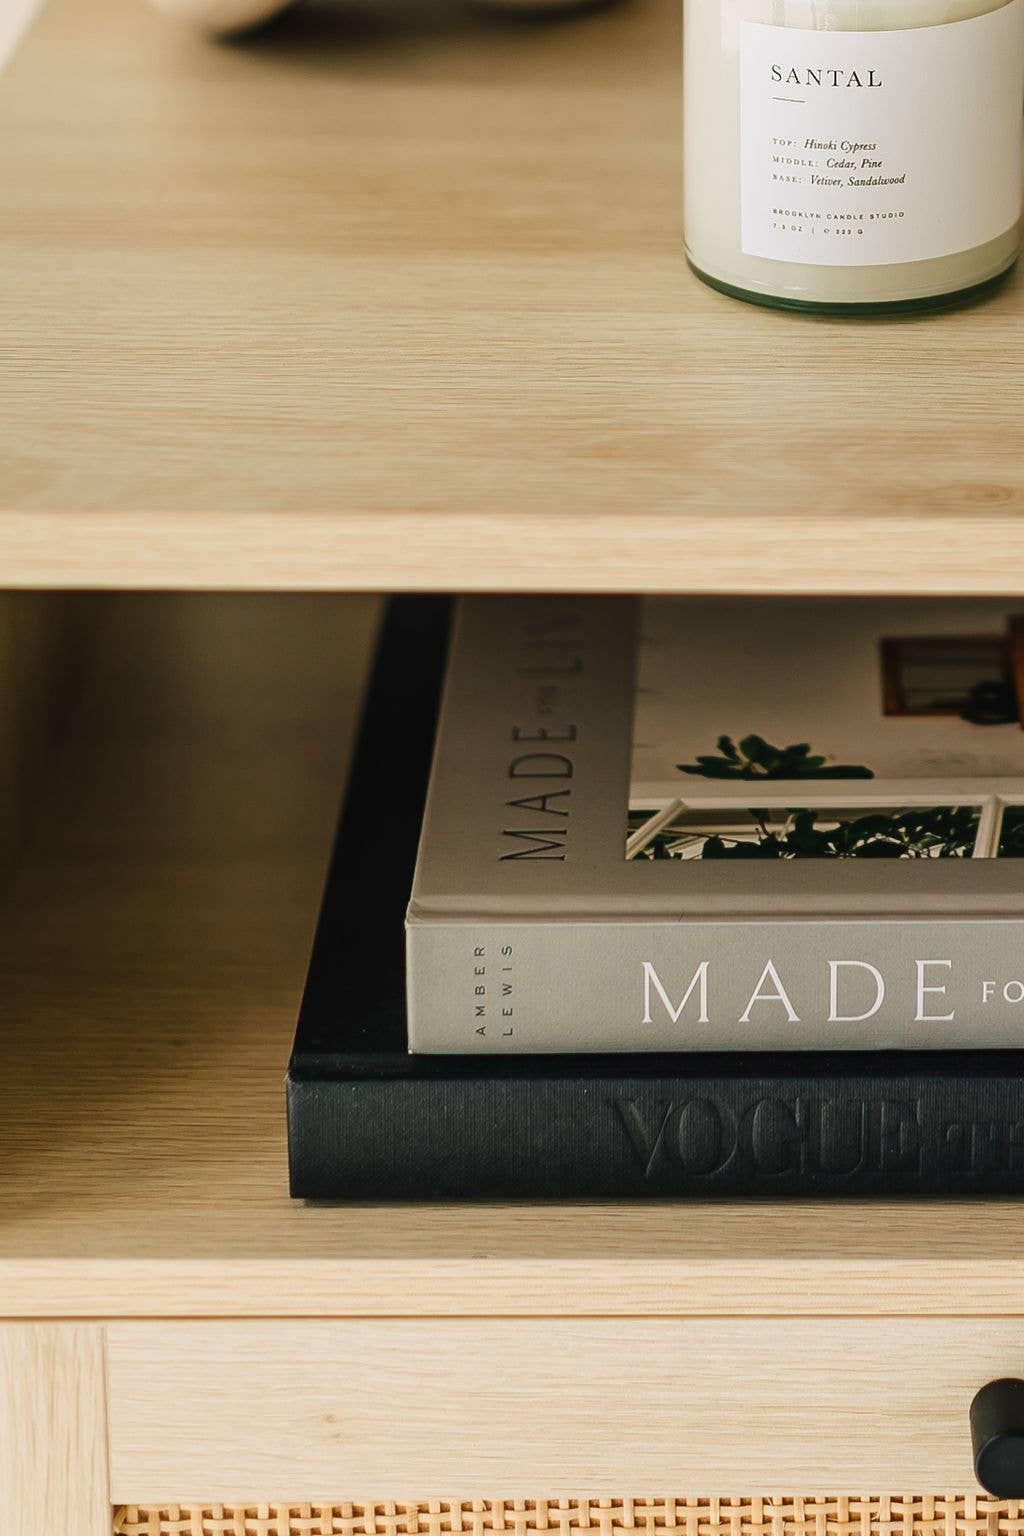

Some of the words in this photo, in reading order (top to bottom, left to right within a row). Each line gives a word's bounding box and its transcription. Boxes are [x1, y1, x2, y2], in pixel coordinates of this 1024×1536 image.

[770, 63, 884, 88] SANTAL
[771, 155, 819, 168] MIDDLE:
[826, 157, 858, 171] Cedar,
[861, 158, 883, 169] Pine
[772, 137, 798, 147] TOP:
[804, 138, 837, 151] Hinoki
[840, 140, 877, 153] Cypress
[772, 173, 803, 184] BASE:
[810, 174, 844, 188] Vetiver,
[847, 173, 907, 187] Sandalwood
[772, 208, 822, 219] BROOKLYN
[826, 213, 864, 221] CANDLE
[869, 211, 906, 220] STUDIO
[498, 722, 578, 863] MADE
[473, 945, 487, 1036] AMBER
[500, 944, 514, 1037] LEWIS
[640, 957, 957, 1026] MADE
[609, 1095, 926, 1178] VOGUE
